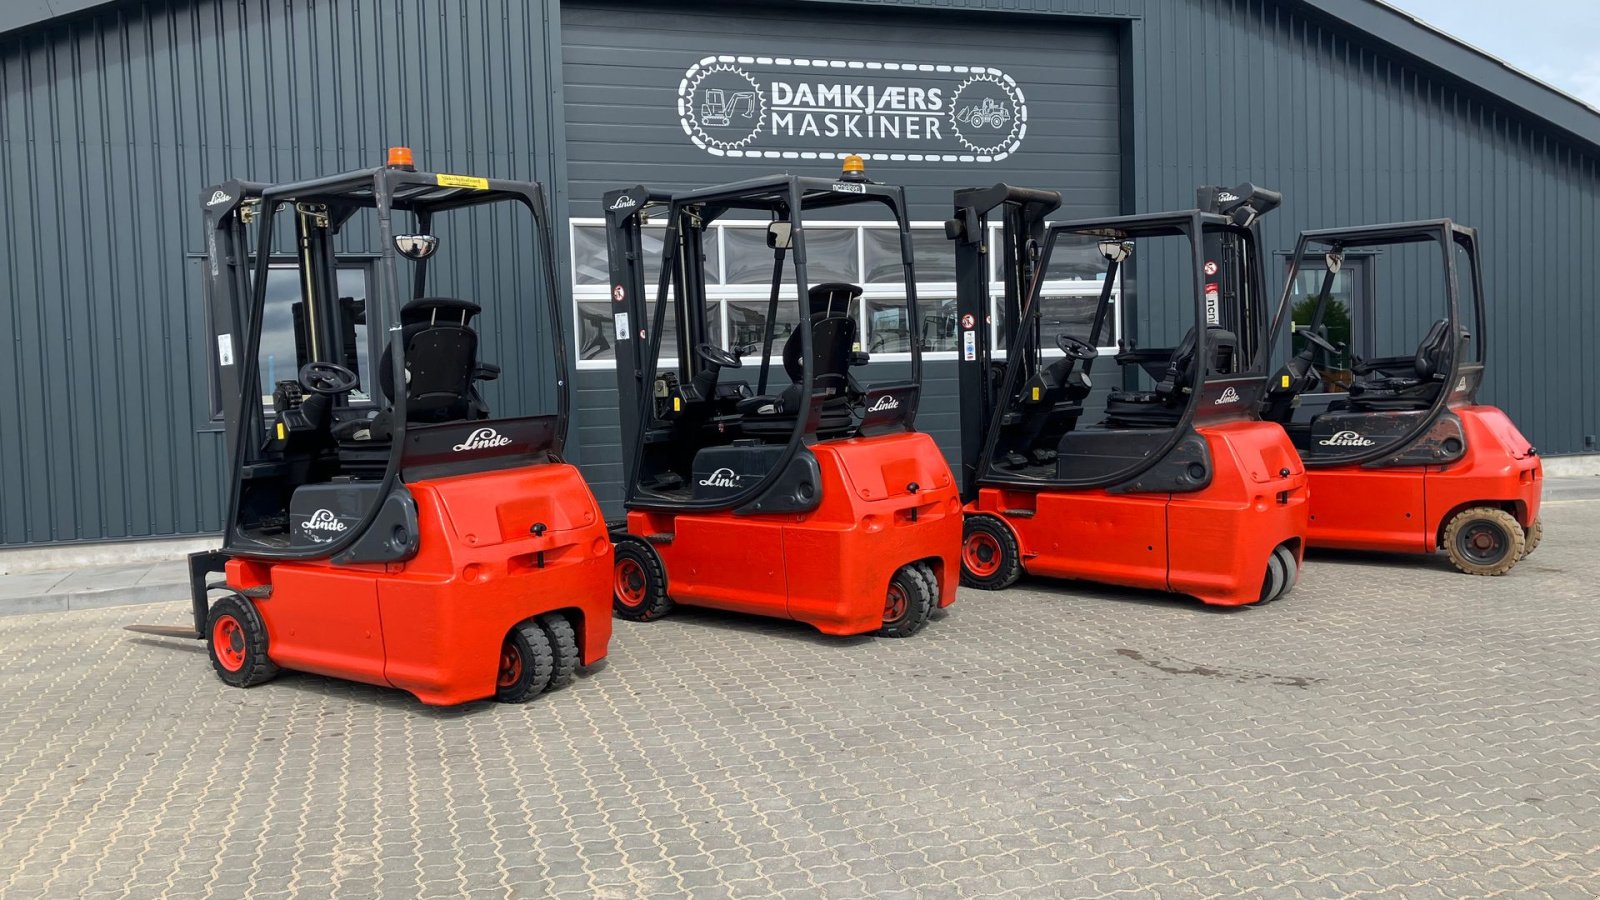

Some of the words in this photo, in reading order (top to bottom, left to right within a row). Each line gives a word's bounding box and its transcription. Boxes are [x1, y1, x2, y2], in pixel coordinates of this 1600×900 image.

[771, 81, 943, 114] DAMKJÆRS
[771, 112, 943, 140] MASKINER
[206, 190, 232, 206] Linde
[609, 195, 636, 209] Linde
[1207, 300, 1219, 325] ncni
[867, 394, 899, 412] Linde
[1214, 387, 1240, 405] Linde
[452, 427, 512, 452] Linde
[1318, 430, 1376, 447] Linde
[699, 467, 743, 488] Lin
[301, 508, 347, 532] Linde
